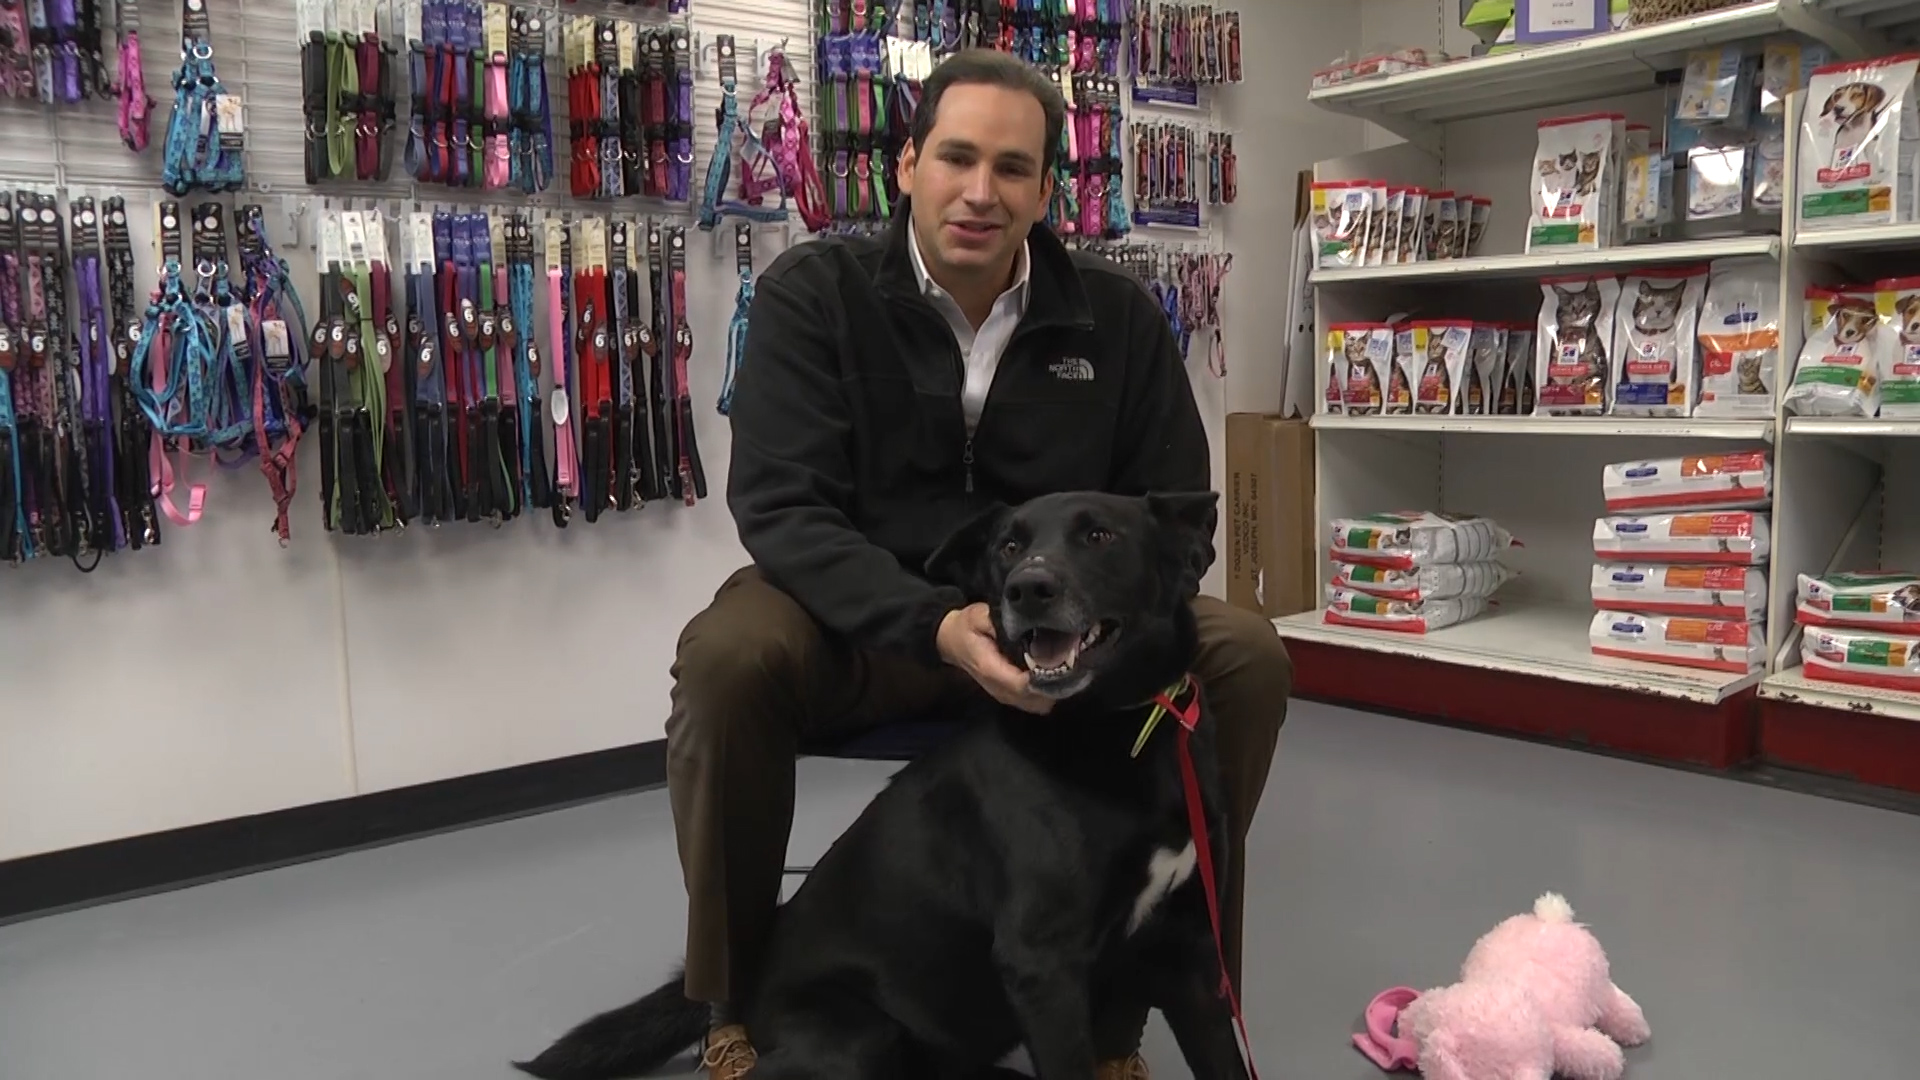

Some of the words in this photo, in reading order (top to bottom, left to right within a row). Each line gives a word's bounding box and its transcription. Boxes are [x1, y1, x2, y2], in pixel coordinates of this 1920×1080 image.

[464, 308, 473, 323] 6
[584, 310, 591, 323] 6
[387, 319, 397, 334] 6
[409, 320, 419, 333] 6
[449, 322, 459, 337] 6
[483, 320, 493, 335] 6
[502, 318, 512, 332] 6
[129, 325, 140, 341] 6
[315, 328, 326, 343] 6
[332, 326, 343, 341] 6
[595, 334, 605, 347] 6
[640, 329, 650, 343] 6
[32, 335, 44, 352] 6
[347, 338, 357, 353] 6
[377, 340, 387, 355] 6
[624, 335, 632, 347] 6
[118, 343, 127, 359] 6
[421, 347, 431, 362] 6
[529, 348, 537, 362] 6
[1048, 364, 1079, 372] NORTH
[1057, 372, 1079, 380] FACE
